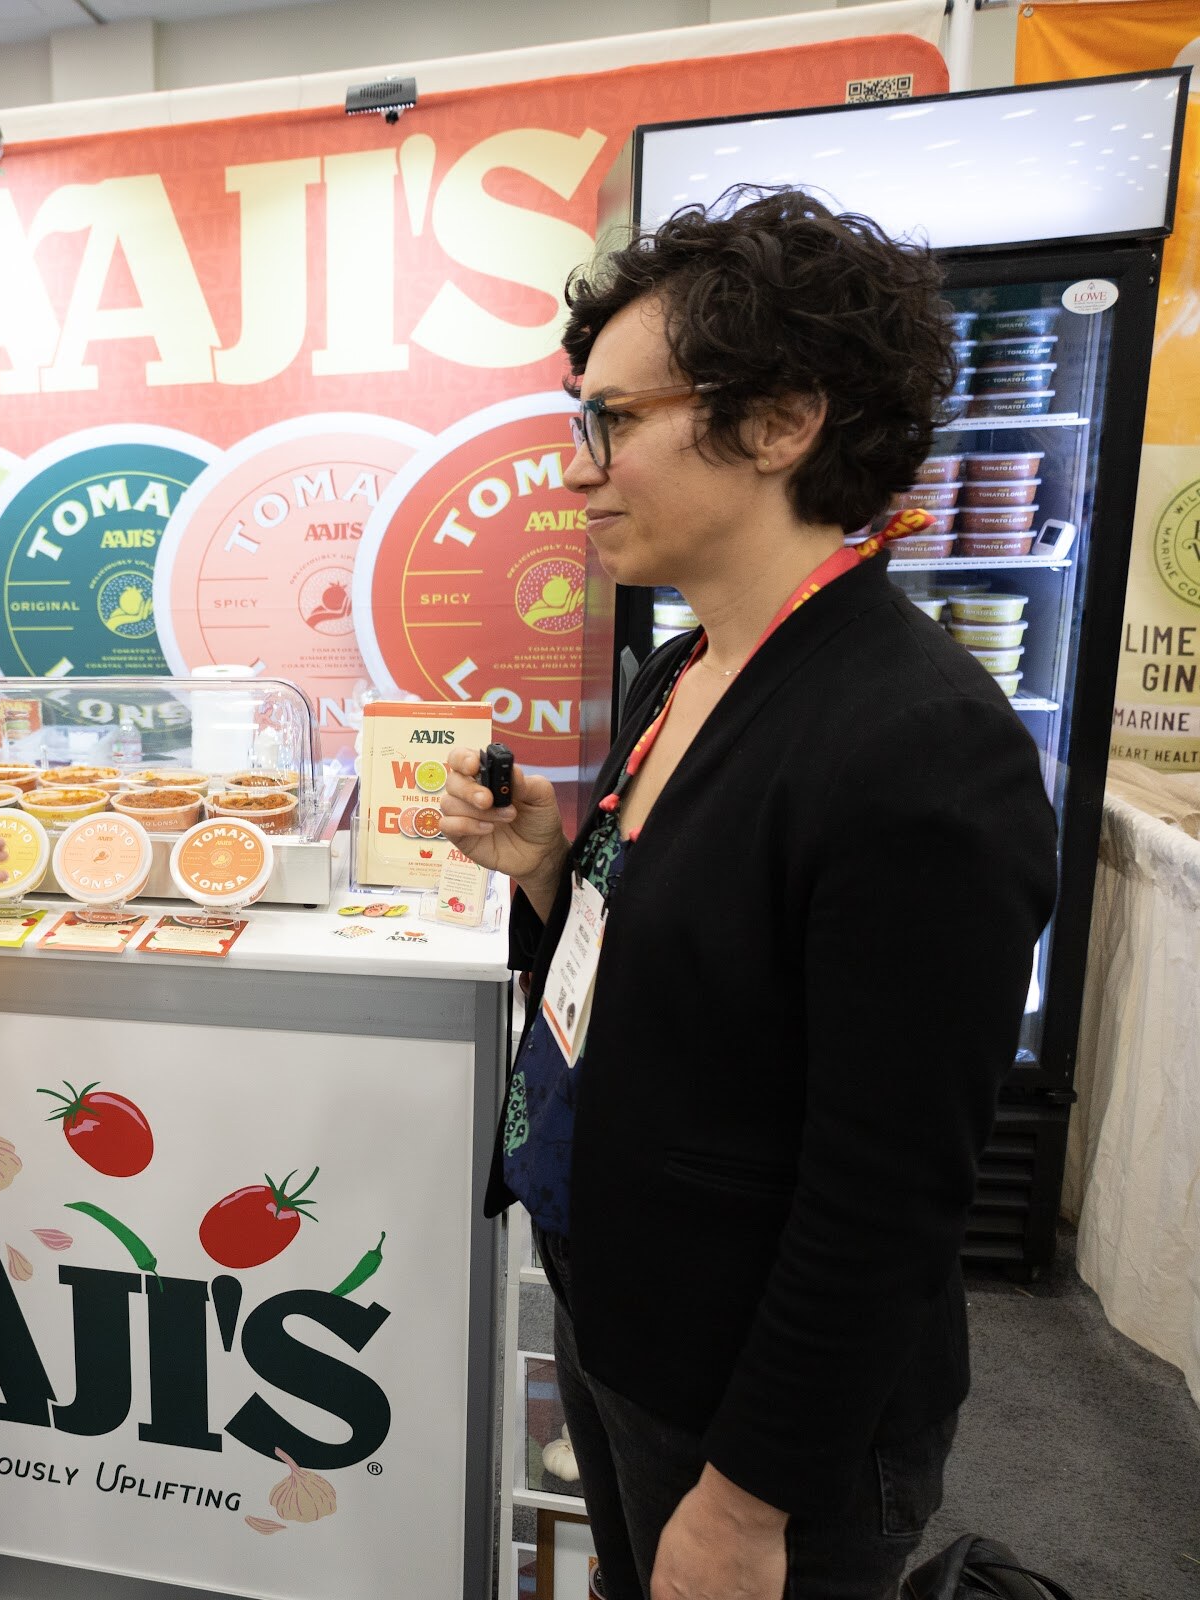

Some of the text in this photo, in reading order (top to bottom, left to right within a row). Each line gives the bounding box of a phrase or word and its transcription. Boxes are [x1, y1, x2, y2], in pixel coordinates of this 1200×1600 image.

[1074, 291, 1107, 302] LOWE
[434, 452, 564, 547] TOM
[26, 478, 172, 561] TOMA
[224, 468, 380, 554] TOMA
[524, 509, 587, 532] AAJI'S
[101, 528, 157, 549] AAJI'S
[304, 522, 363, 541] AAJI'S
[507, 544, 561, 579] DELICIOUSLY
[1161, 527, 1178, 580] MARINE
[10, 601, 80, 612] ORIGINAL
[214, 599, 258, 608] SPICY
[420, 593, 471, 605] SPICY
[1125, 624, 1197, 656] LIME
[1112, 708, 1190, 732] MARINE
[409, 730, 455, 744] AAJI'S
[1110, 745, 1149, 760] HEART
[75, 823, 134, 846] TOMATO
[192, 827, 255, 850] TOMATO
[71, 868, 125, 888] LONSA
[190, 872, 248, 891] LONSA
